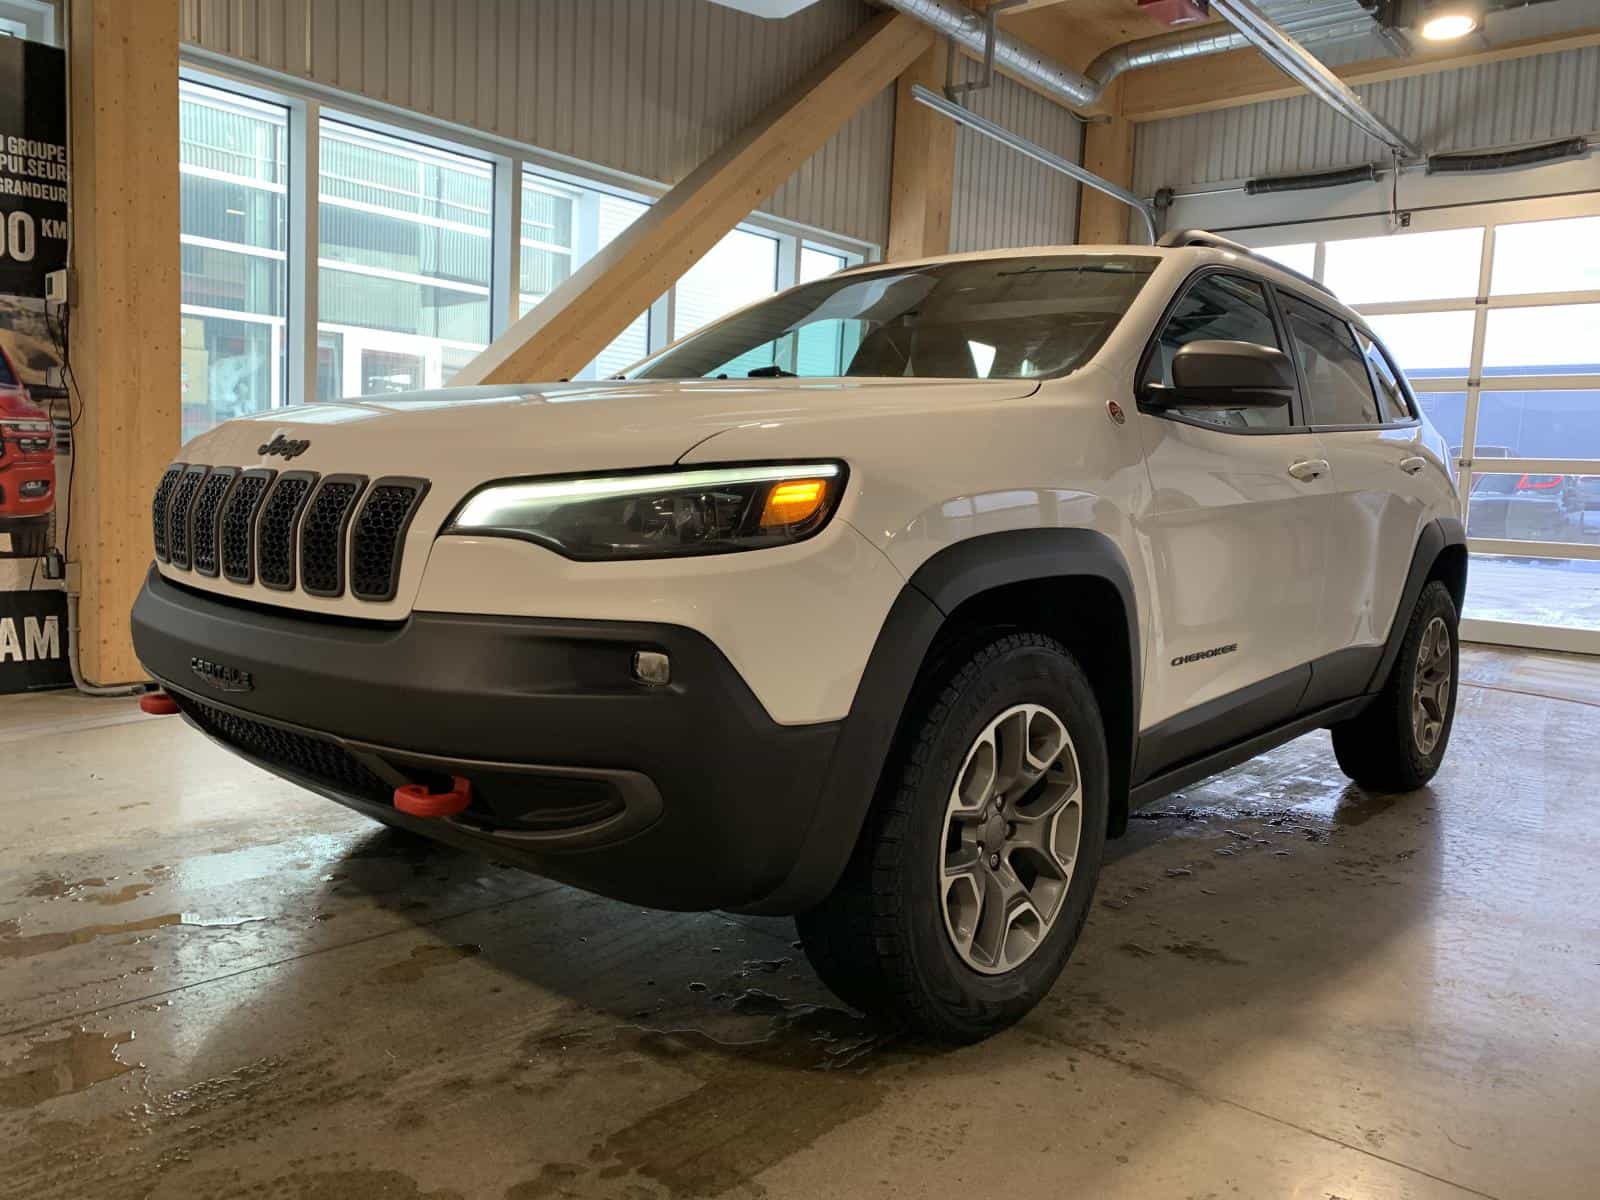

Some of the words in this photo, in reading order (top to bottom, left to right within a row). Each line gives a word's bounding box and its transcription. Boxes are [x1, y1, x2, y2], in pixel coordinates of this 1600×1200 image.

[8, 136, 66, 163] GROUPE
[0, 153, 67, 181] PULSEUR
[41, 217, 67, 240] KM
[258, 434, 310, 461] Jeep
[1171, 643, 1238, 666] CHEROKEE
